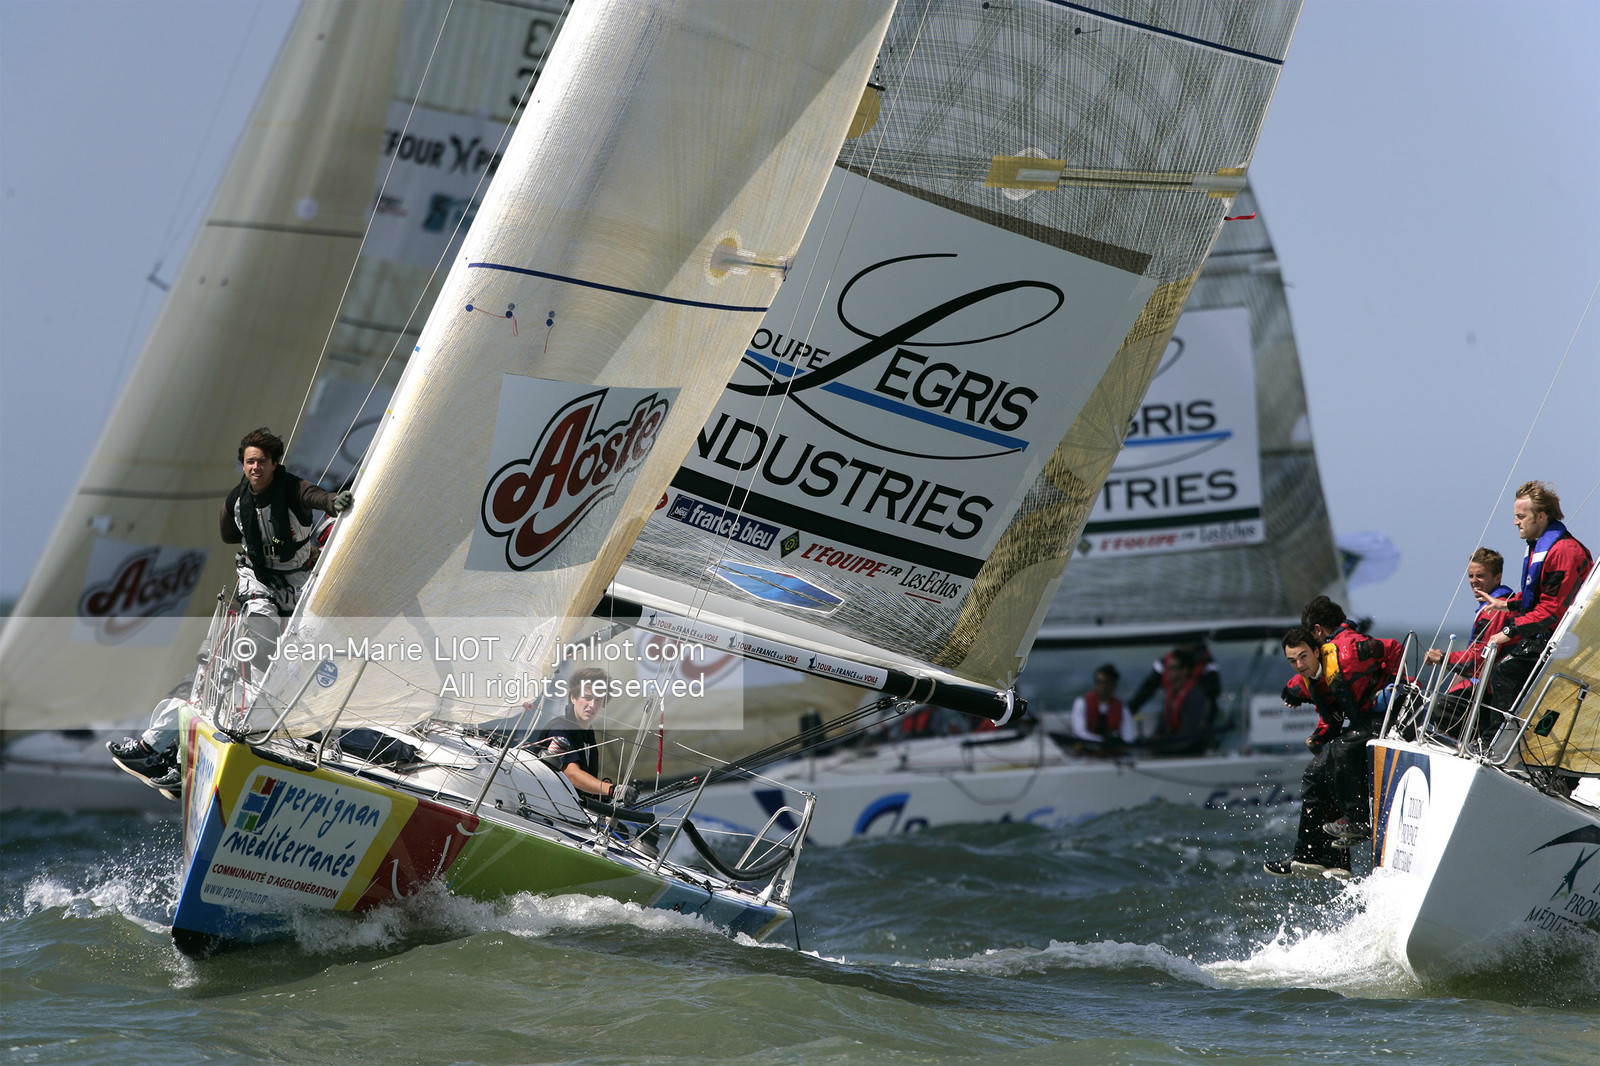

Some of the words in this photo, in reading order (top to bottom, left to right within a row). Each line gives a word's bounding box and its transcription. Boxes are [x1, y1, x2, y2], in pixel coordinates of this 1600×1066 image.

[490, 400, 663, 558] Aoste
[688, 503, 742, 538] france
[739, 521, 774, 548] bleu
[656, 619, 672, 630] TOUR
[736, 641, 752, 651] TOUR
[816, 662, 832, 672] TOUR
[272, 784, 381, 839] perpignan
[212, 863, 267, 883] COMMUNAUTÉ
[266, 874, 340, 900] D'AGGLOMÉRATION
